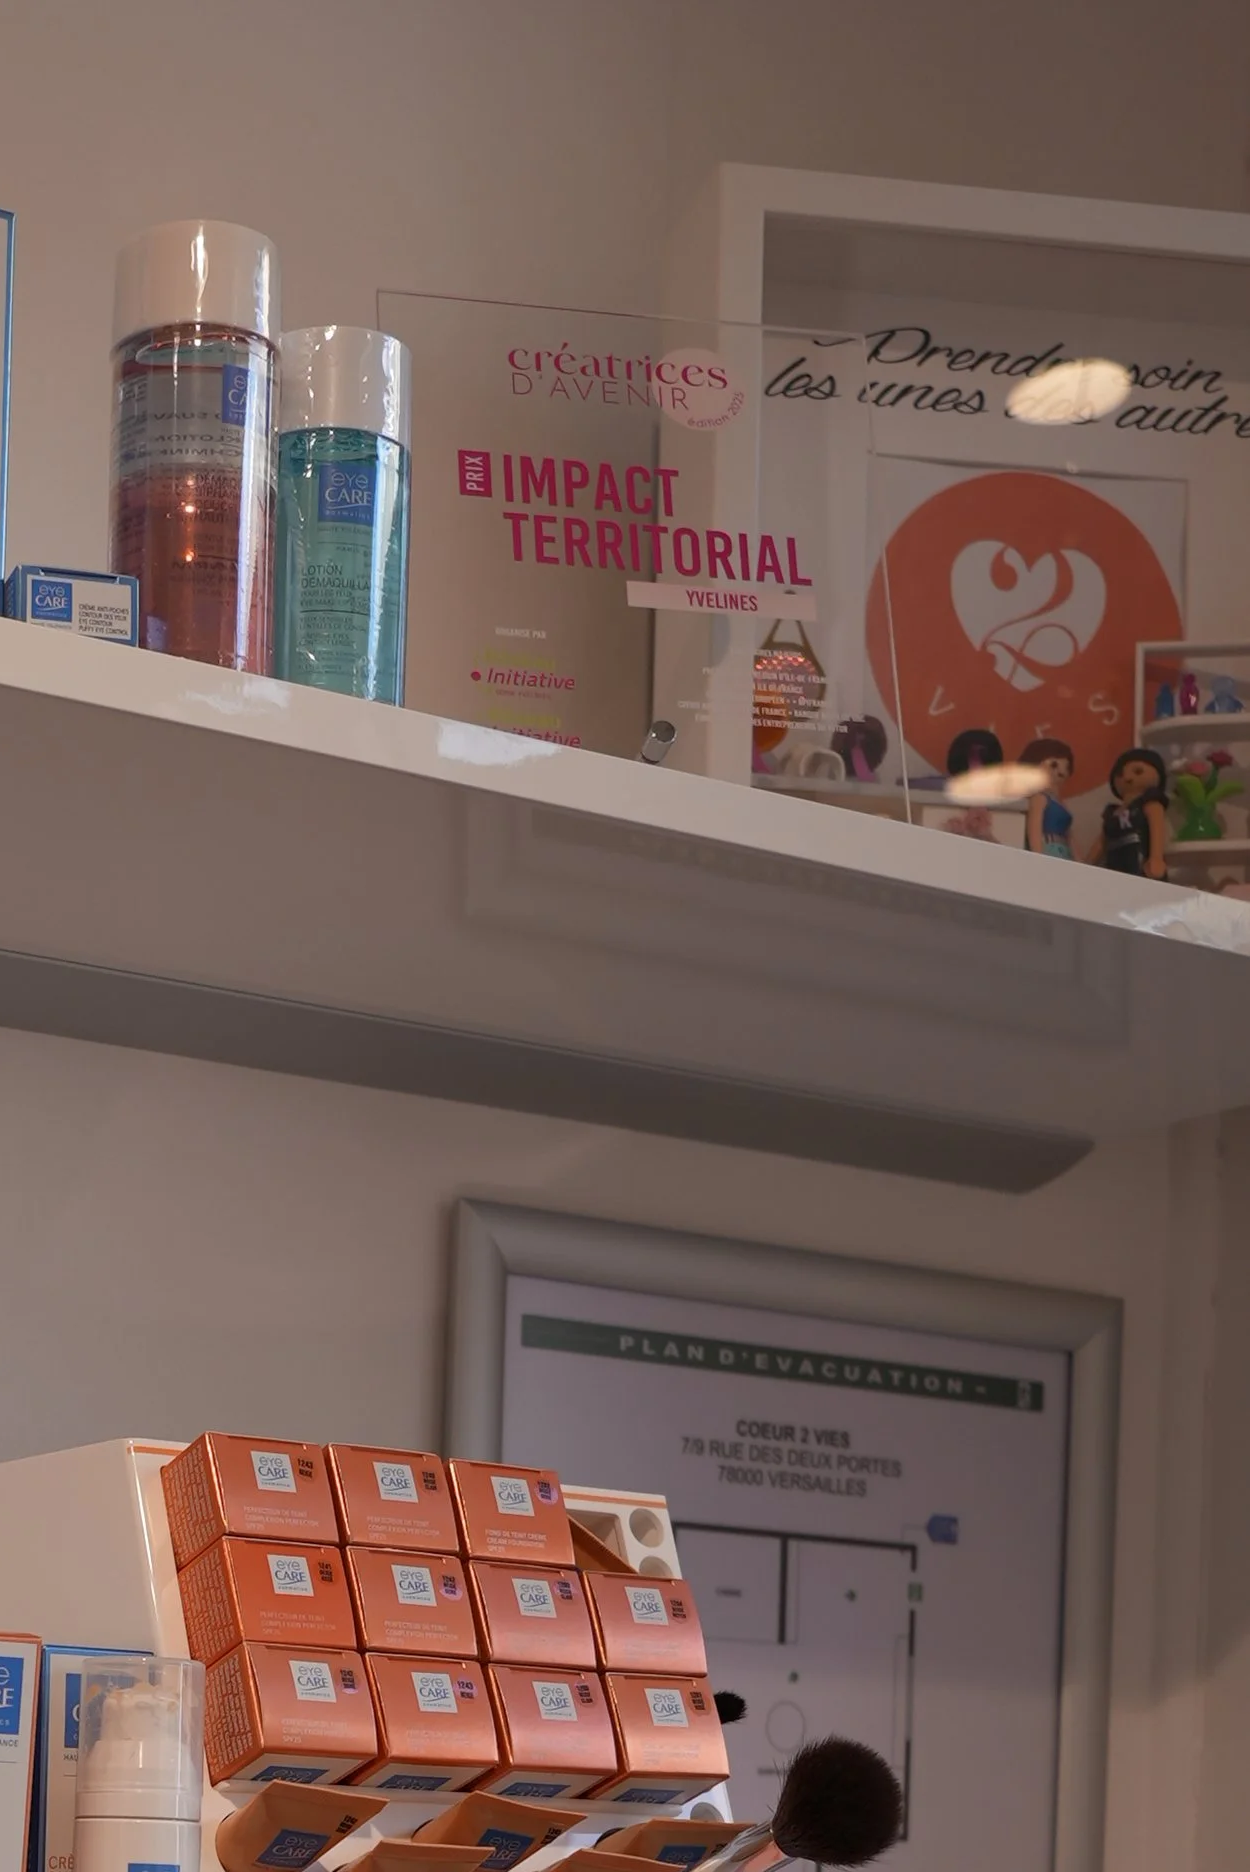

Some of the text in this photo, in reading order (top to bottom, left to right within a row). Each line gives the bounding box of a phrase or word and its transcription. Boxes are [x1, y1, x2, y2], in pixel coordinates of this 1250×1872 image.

[508, 342, 729, 390] créatrices
[511, 372, 690, 411] D'AVENIR
[764, 357, 842, 398] les
[856, 380, 988, 414] unes
[466, 454, 485, 492] PRIX
[503, 454, 679, 517] IMPACT
[502, 511, 813, 587] TERRITORIAL
[686, 589, 758, 612] YVELINES
[486, 668, 576, 691] Initiative
[619, 1335, 705, 1361] PLAN
[736, 1419, 851, 1450] COEUR 2 VIES
[680, 1436, 901, 1478] 7/9 RUE DES DEUX PORTES
[717, 1464, 867, 1497] 78000 VERSAILLES
